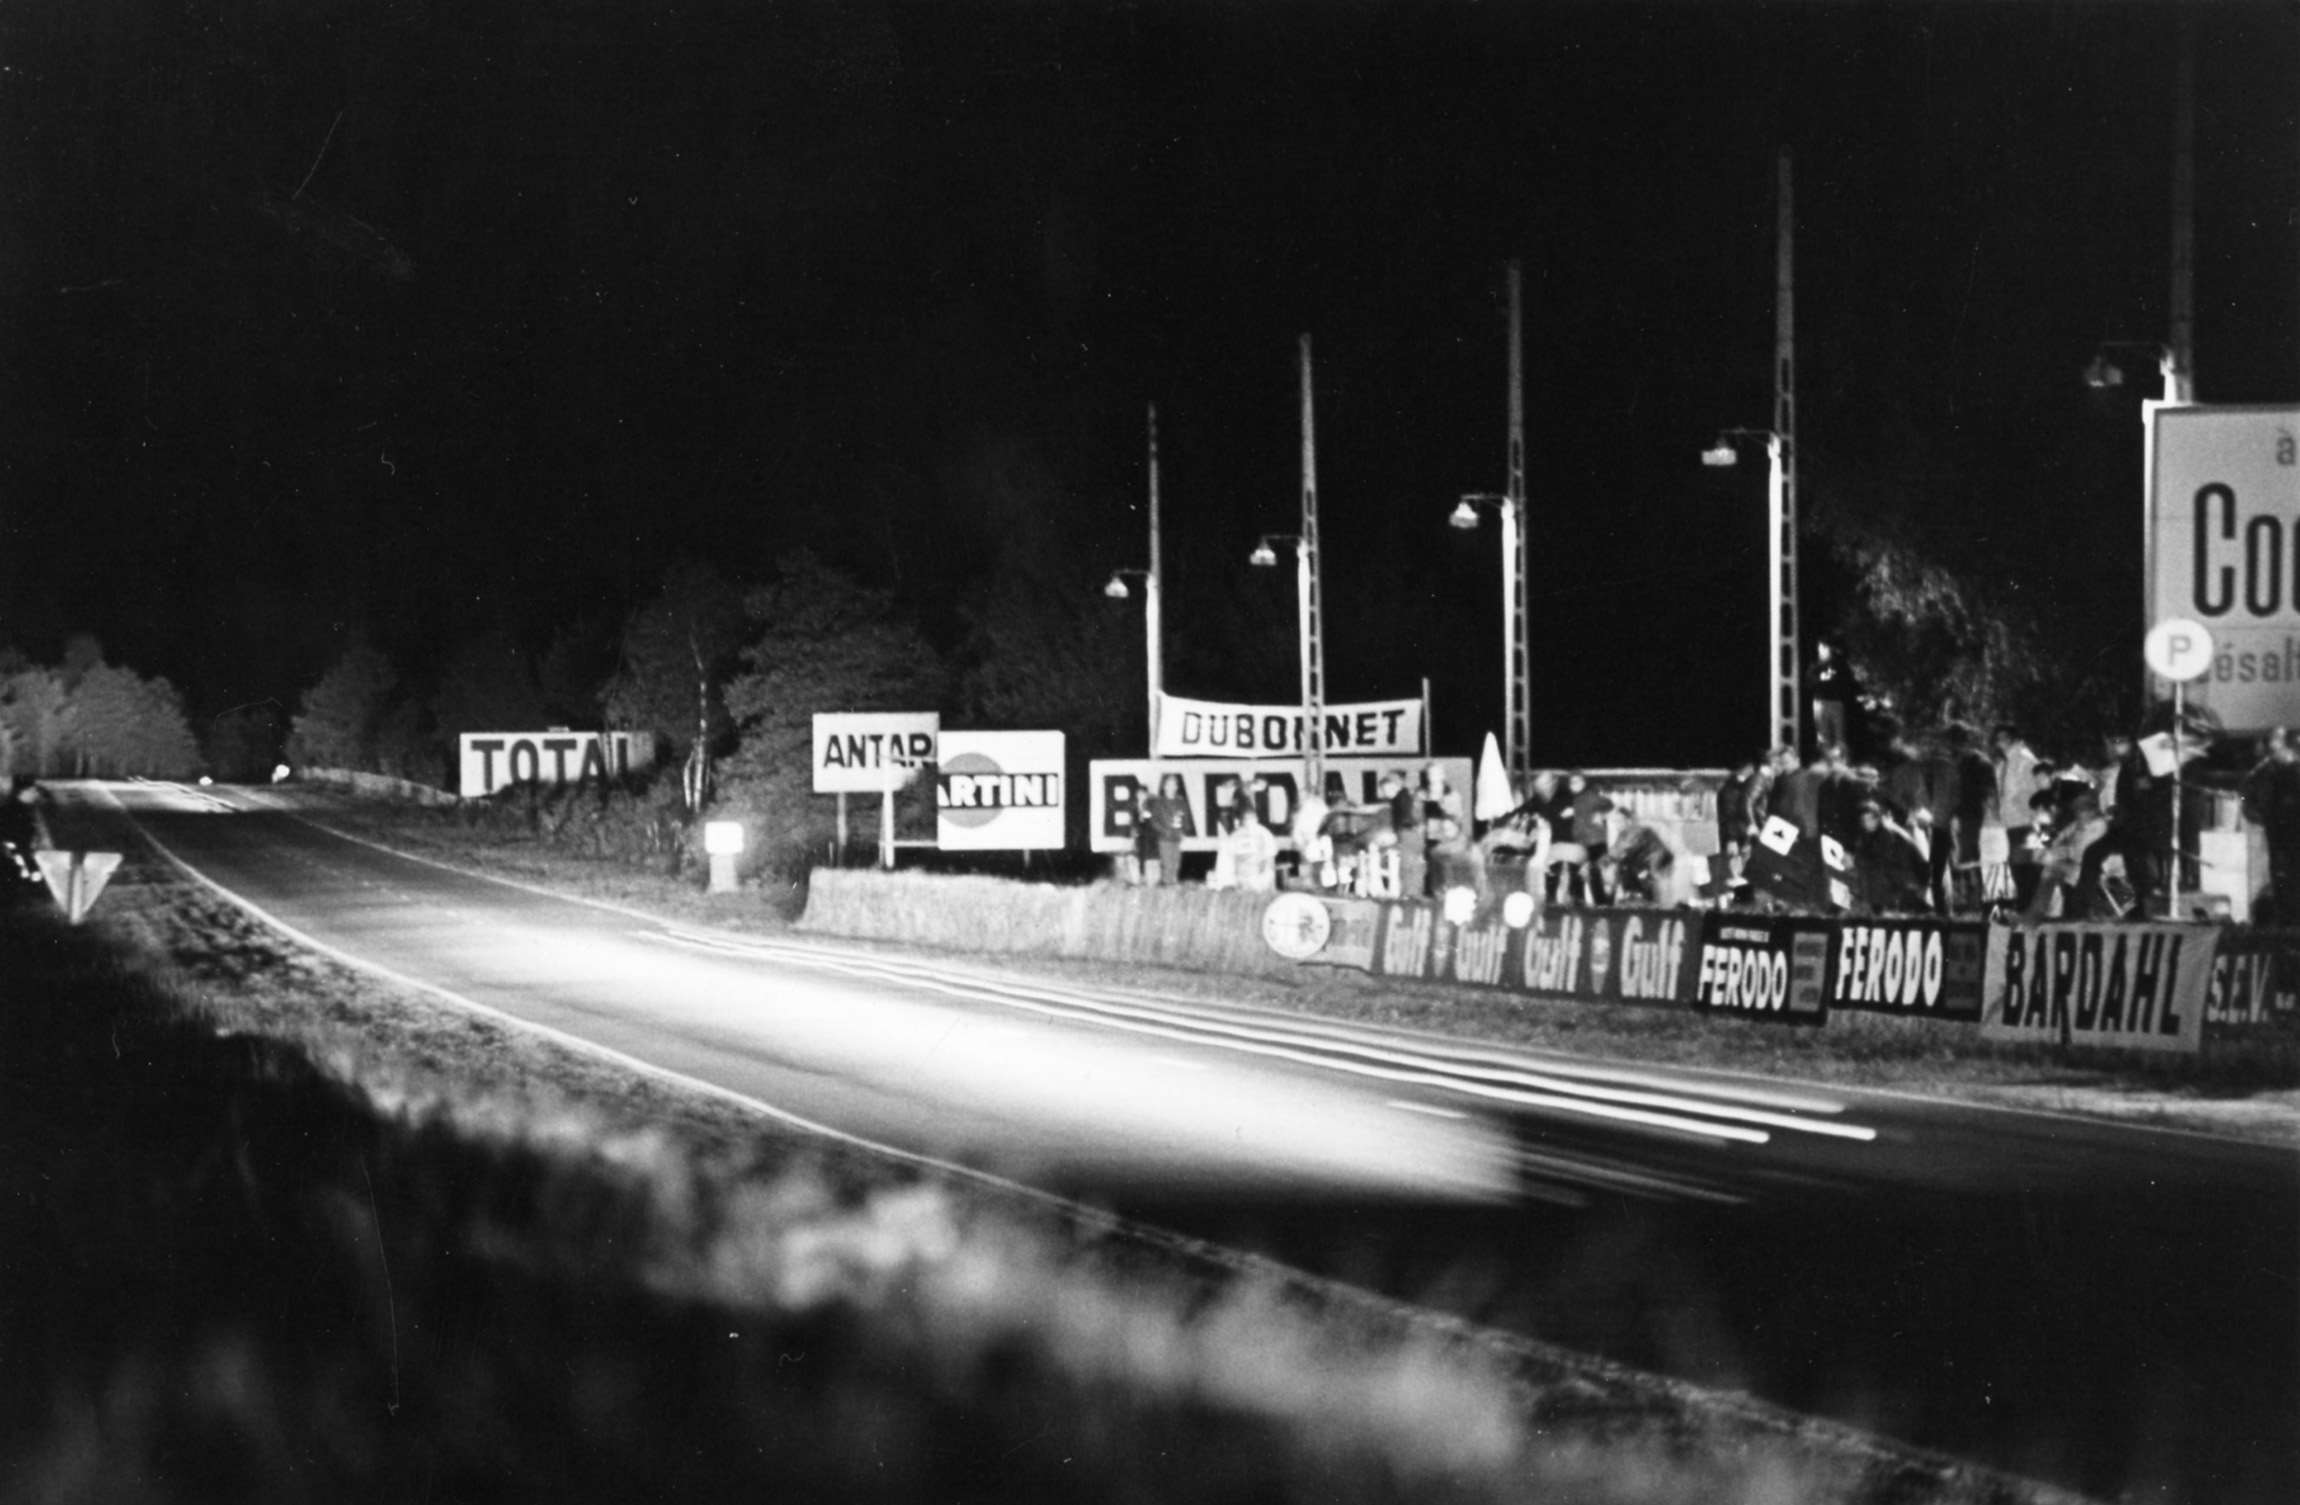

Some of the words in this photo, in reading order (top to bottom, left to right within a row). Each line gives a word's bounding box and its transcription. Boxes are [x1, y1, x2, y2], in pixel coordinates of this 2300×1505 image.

[2194, 482, 2300, 617] Co
[2168, 634, 2192, 667] P
[2195, 636, 2300, 684] ésal
[824, 733, 933, 768] ANTAR
[1620, 915, 1684, 1000] Gulf
[1697, 944, 1788, 1011] FERODO
[1835, 926, 1943, 1007] FERODO
[2002, 931, 2183, 1044] BARDAHL
